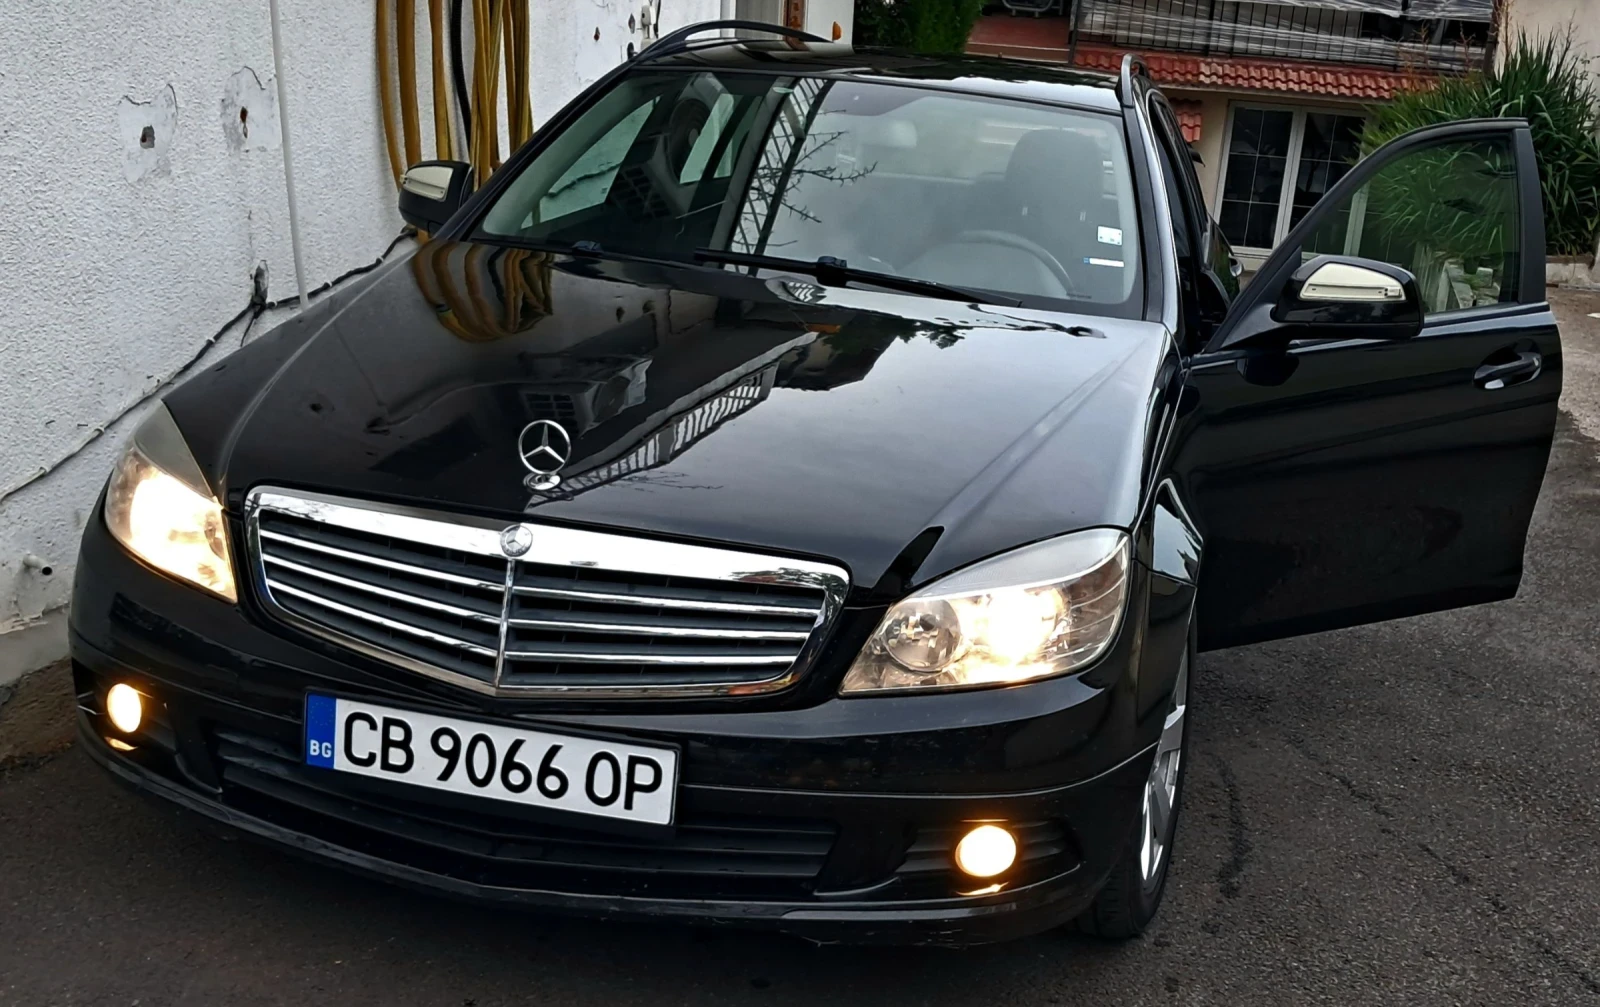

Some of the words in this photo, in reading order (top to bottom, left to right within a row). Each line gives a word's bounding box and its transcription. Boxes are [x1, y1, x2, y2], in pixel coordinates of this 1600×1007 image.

[309, 739, 332, 758] BG
[343, 711, 415, 774] CB
[429, 726, 569, 800] 9066
[584, 750, 663, 811] OP
